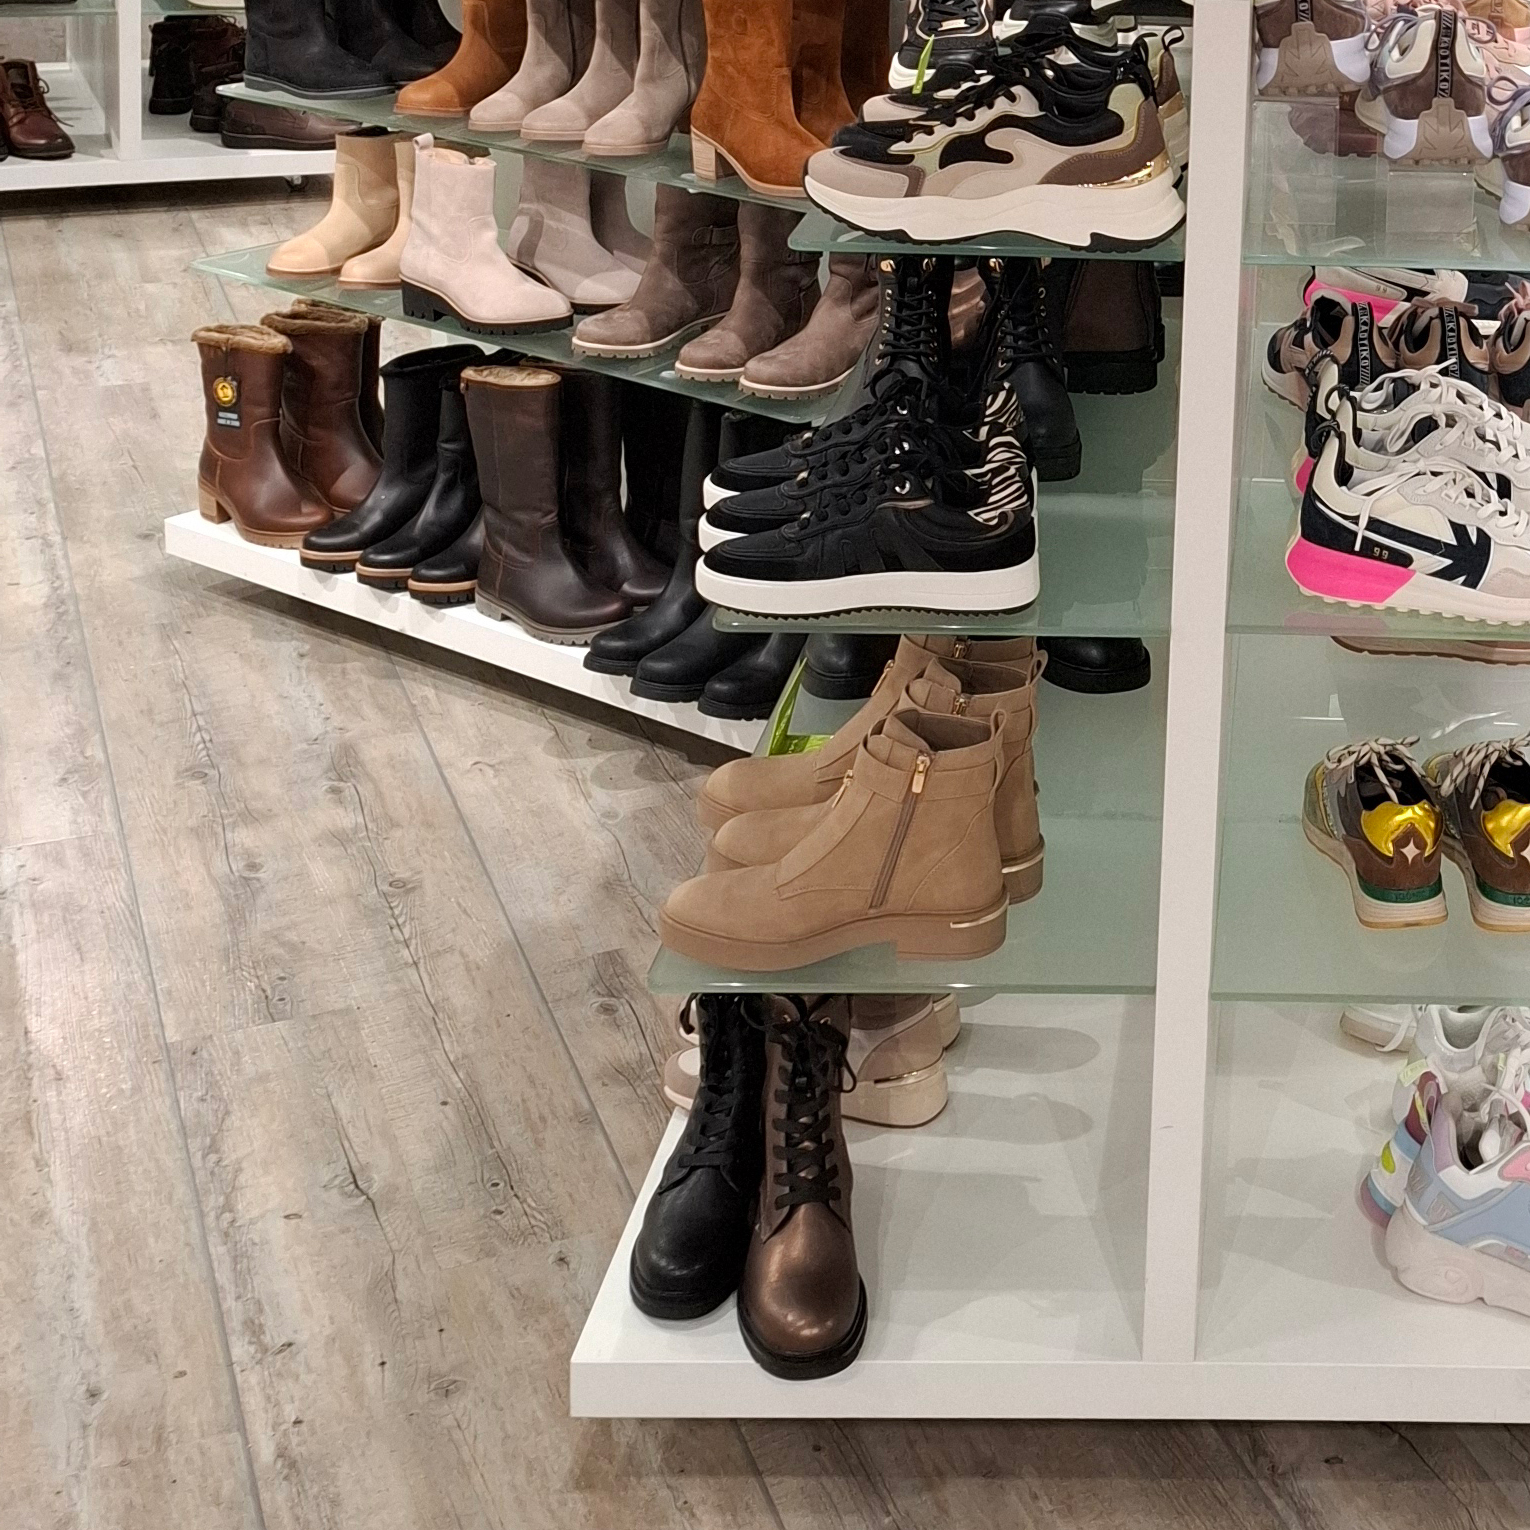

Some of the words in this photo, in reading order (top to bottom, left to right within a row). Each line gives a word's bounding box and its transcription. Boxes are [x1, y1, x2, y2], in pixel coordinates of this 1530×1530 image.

[1438, 37, 1451, 90] KAOTIKO
[1359, 315, 1370, 366] KAOTIKO
[1373, 546, 1389, 560] 99
